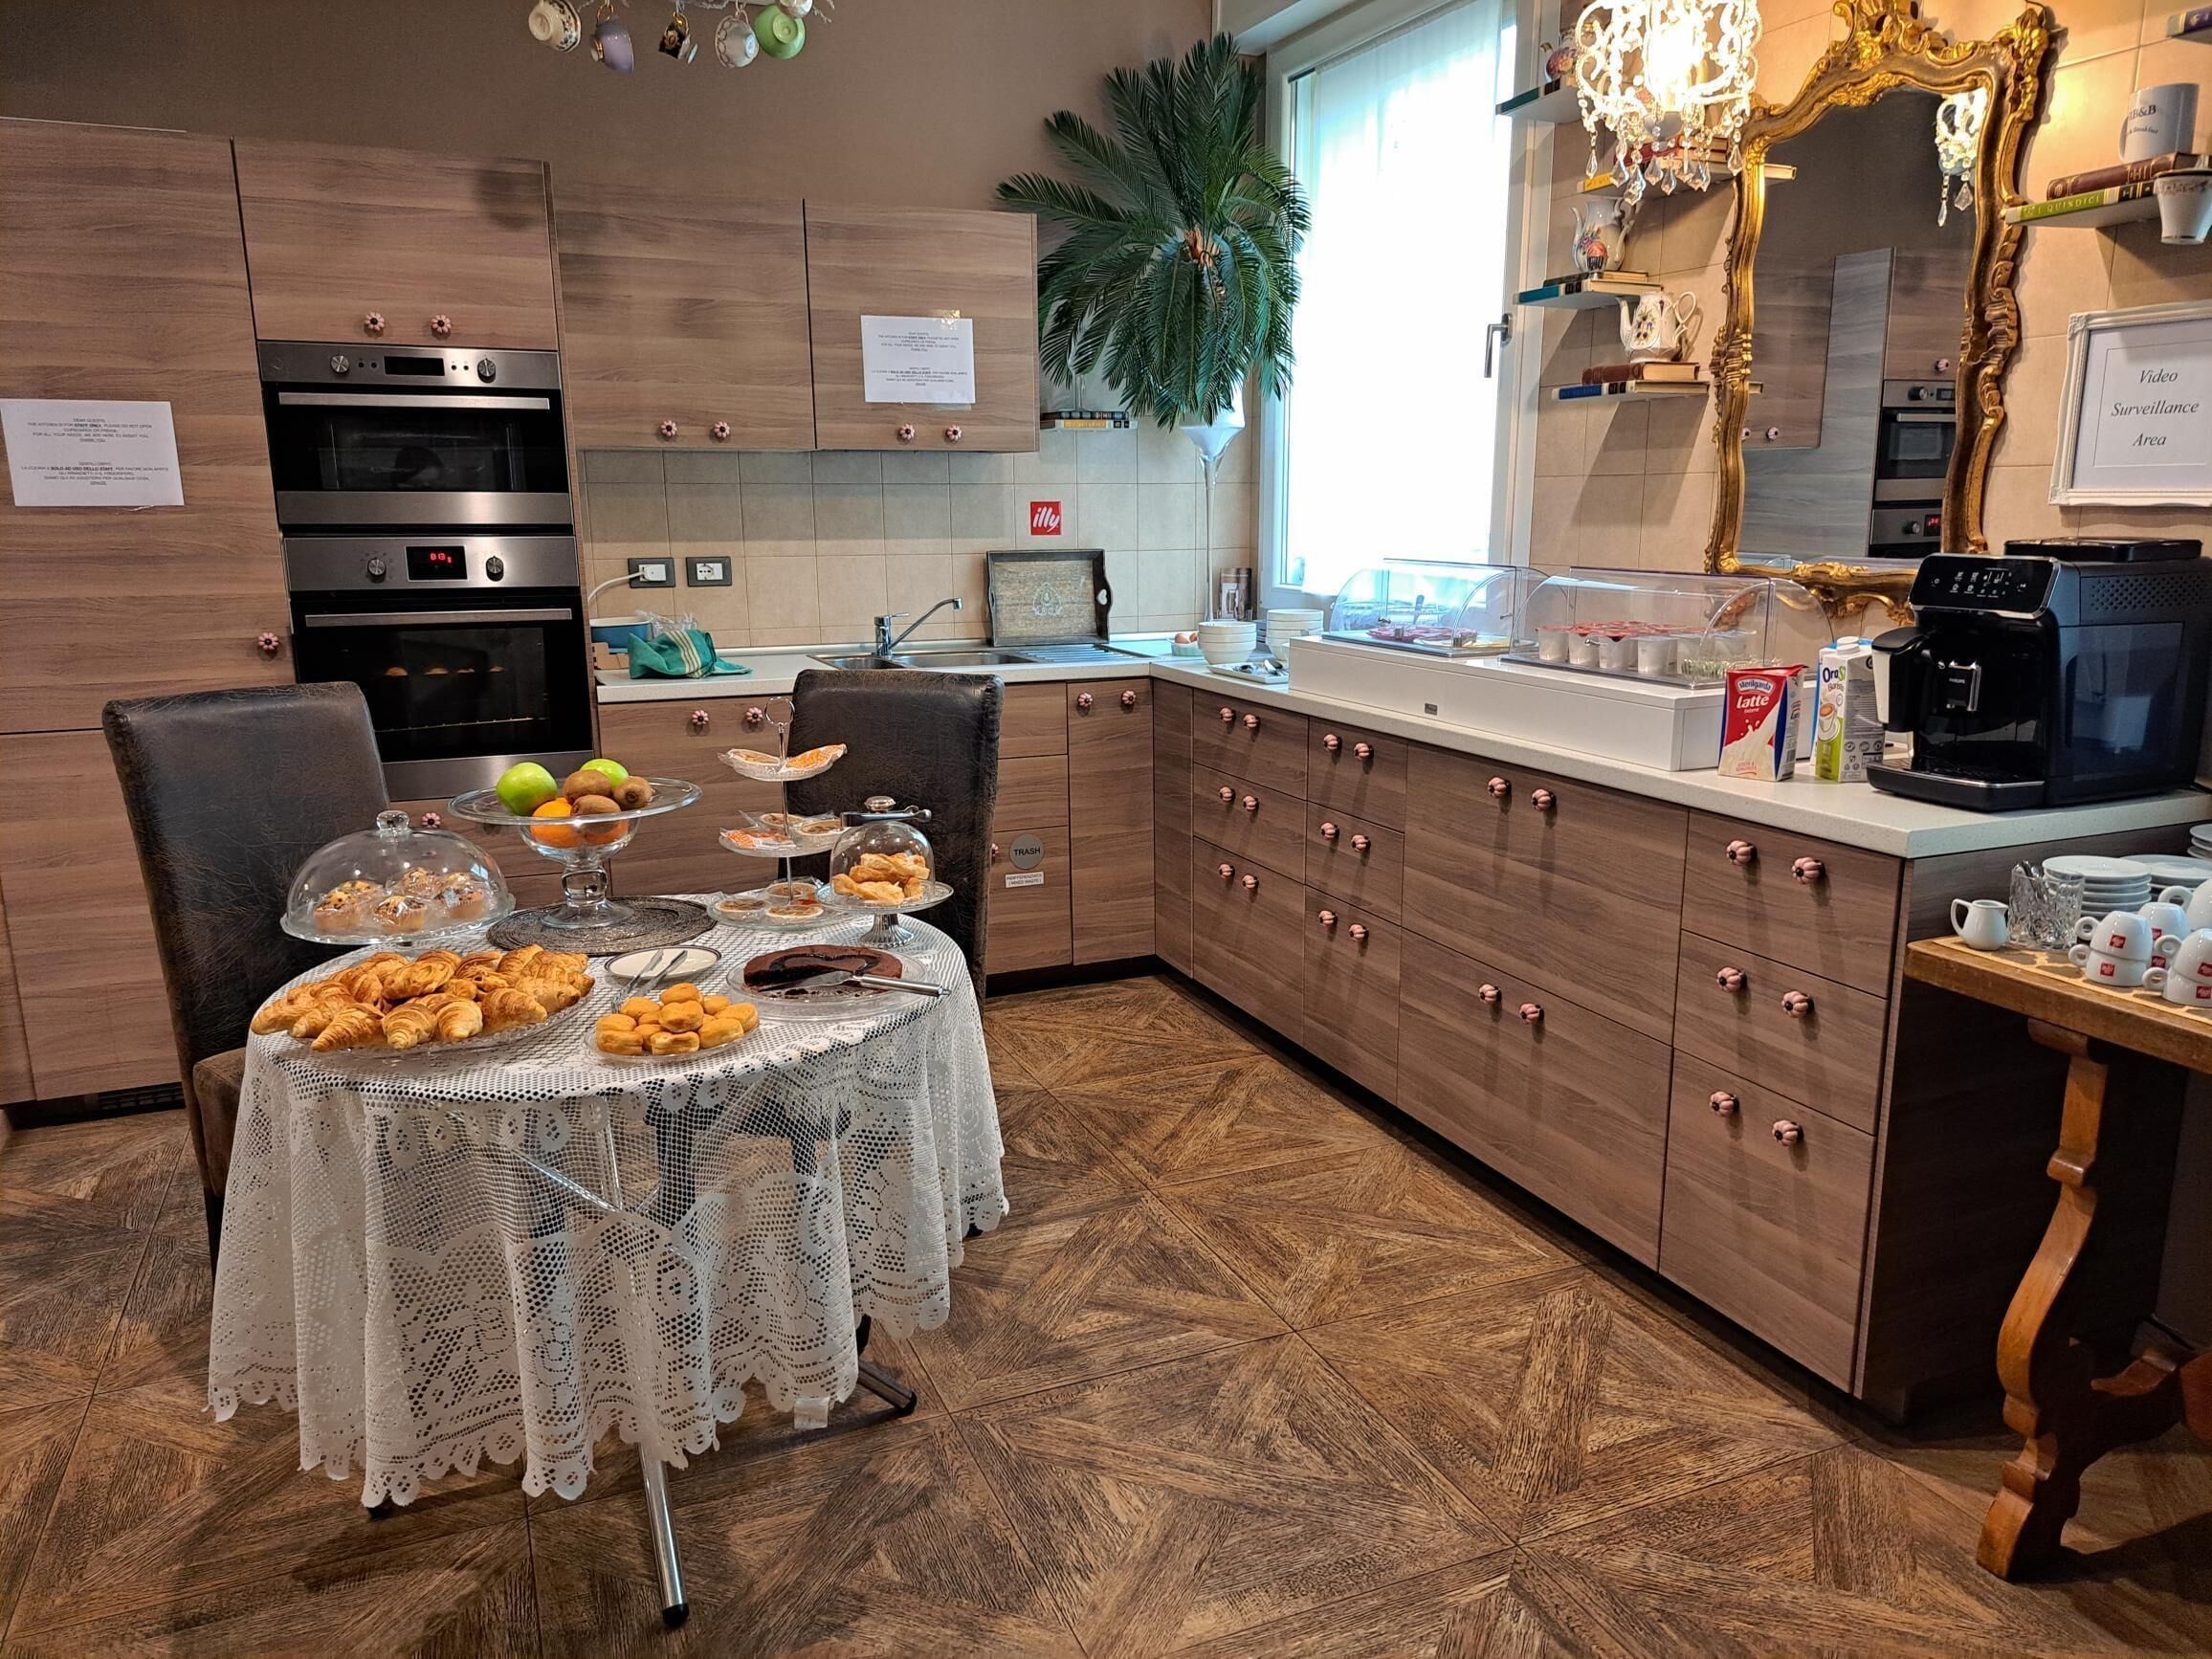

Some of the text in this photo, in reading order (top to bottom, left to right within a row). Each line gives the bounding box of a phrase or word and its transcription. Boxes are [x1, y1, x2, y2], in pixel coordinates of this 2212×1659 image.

[2046, 194, 2100, 212] QUINDICI
[2139, 367, 2179, 384] Video
[2111, 400, 2200, 417] Surveillance
[2133, 432, 2167, 447] Area
[1032, 506, 1060, 533] illy
[1736, 695, 1769, 709] latte
[1013, 847, 1041, 856] TRASH
